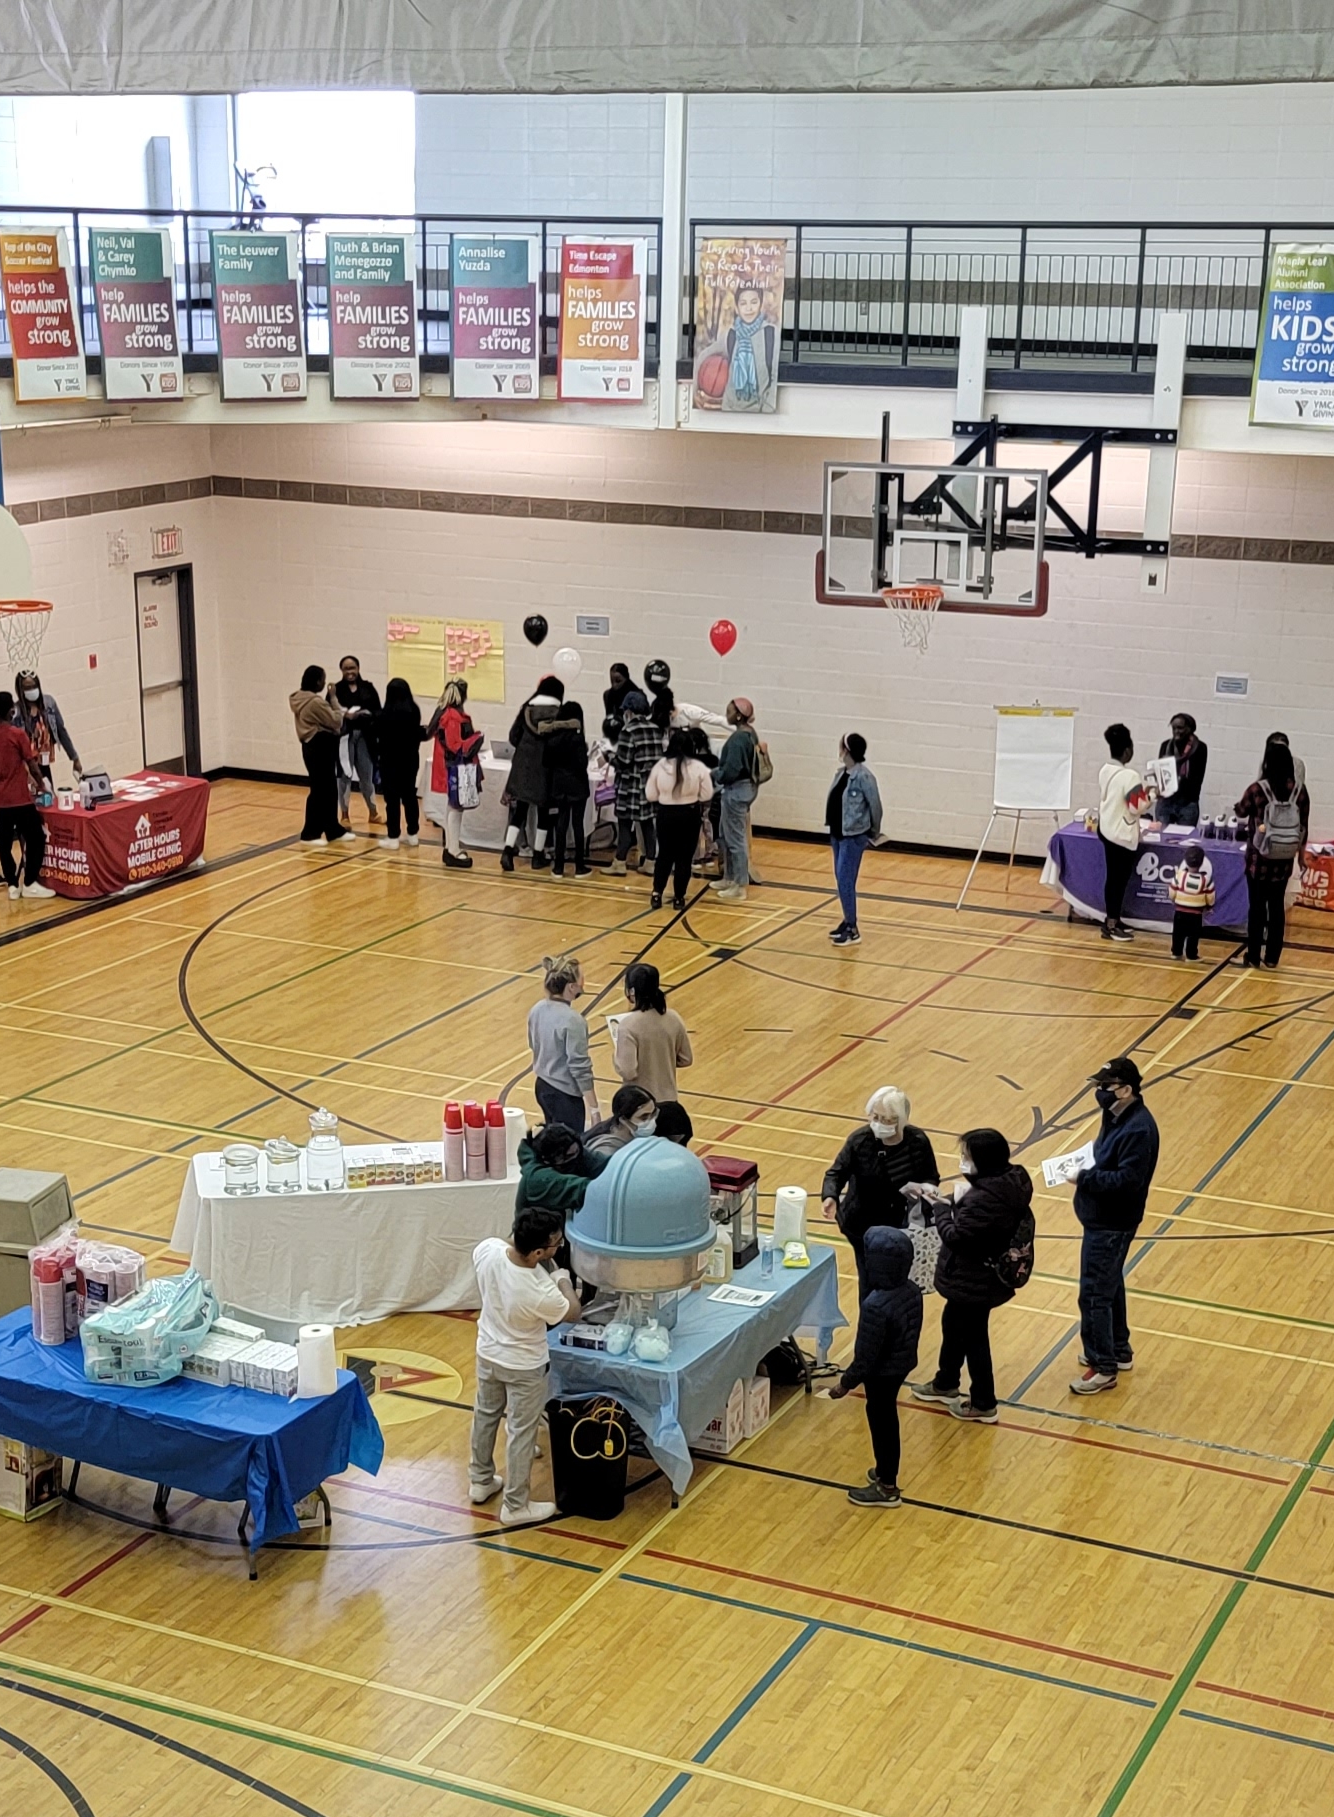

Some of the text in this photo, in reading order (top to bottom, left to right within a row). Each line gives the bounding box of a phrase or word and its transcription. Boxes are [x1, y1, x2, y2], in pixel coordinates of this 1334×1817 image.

[97, 236, 135, 250] Neil, Val
[334, 242, 399, 253] Ruth & Brian
[217, 245, 279, 256] The Leuwer
[459, 247, 506, 258] Annalise
[590, 251, 616, 262] Escape
[707, 242, 780, 260] Inspiring Youth
[98, 252, 134, 264] & Carey
[335, 255, 392, 267] Menegozzo
[1277, 256, 1327, 266] Maple Leaf
[99, 264, 136, 278] Chymko
[219, 259, 253, 272] Family
[459, 260, 490, 271] Yuzda
[569, 264, 609, 273] Edmonton
[705, 260, 778, 271] to Reach Their
[1276, 267, 1308, 276] Alumni
[335, 269, 390, 282] and Family
[705, 275, 769, 289] Full Potential
[8, 280, 54, 296] helps the
[1275, 279, 1325, 289] Association
[568, 286, 602, 299] helps
[11, 299, 68, 315] COMMUNITY
[568, 301, 635, 319] FAMILIES
[1274, 295, 1312, 311] helps
[36, 316, 59, 329] grow
[592, 319, 623, 333] grow
[28, 328, 71, 346] strong
[578, 334, 629, 350] strong
[1296, 340, 1334, 354] grow
[161, 533, 177, 552] EXIT
[129, 828, 180, 854] AFTER HOURS
[55, 847, 87, 862] HOURS
[128, 842, 182, 868] MOBILE CLINIC
[59, 861, 89, 875] CLINIC
